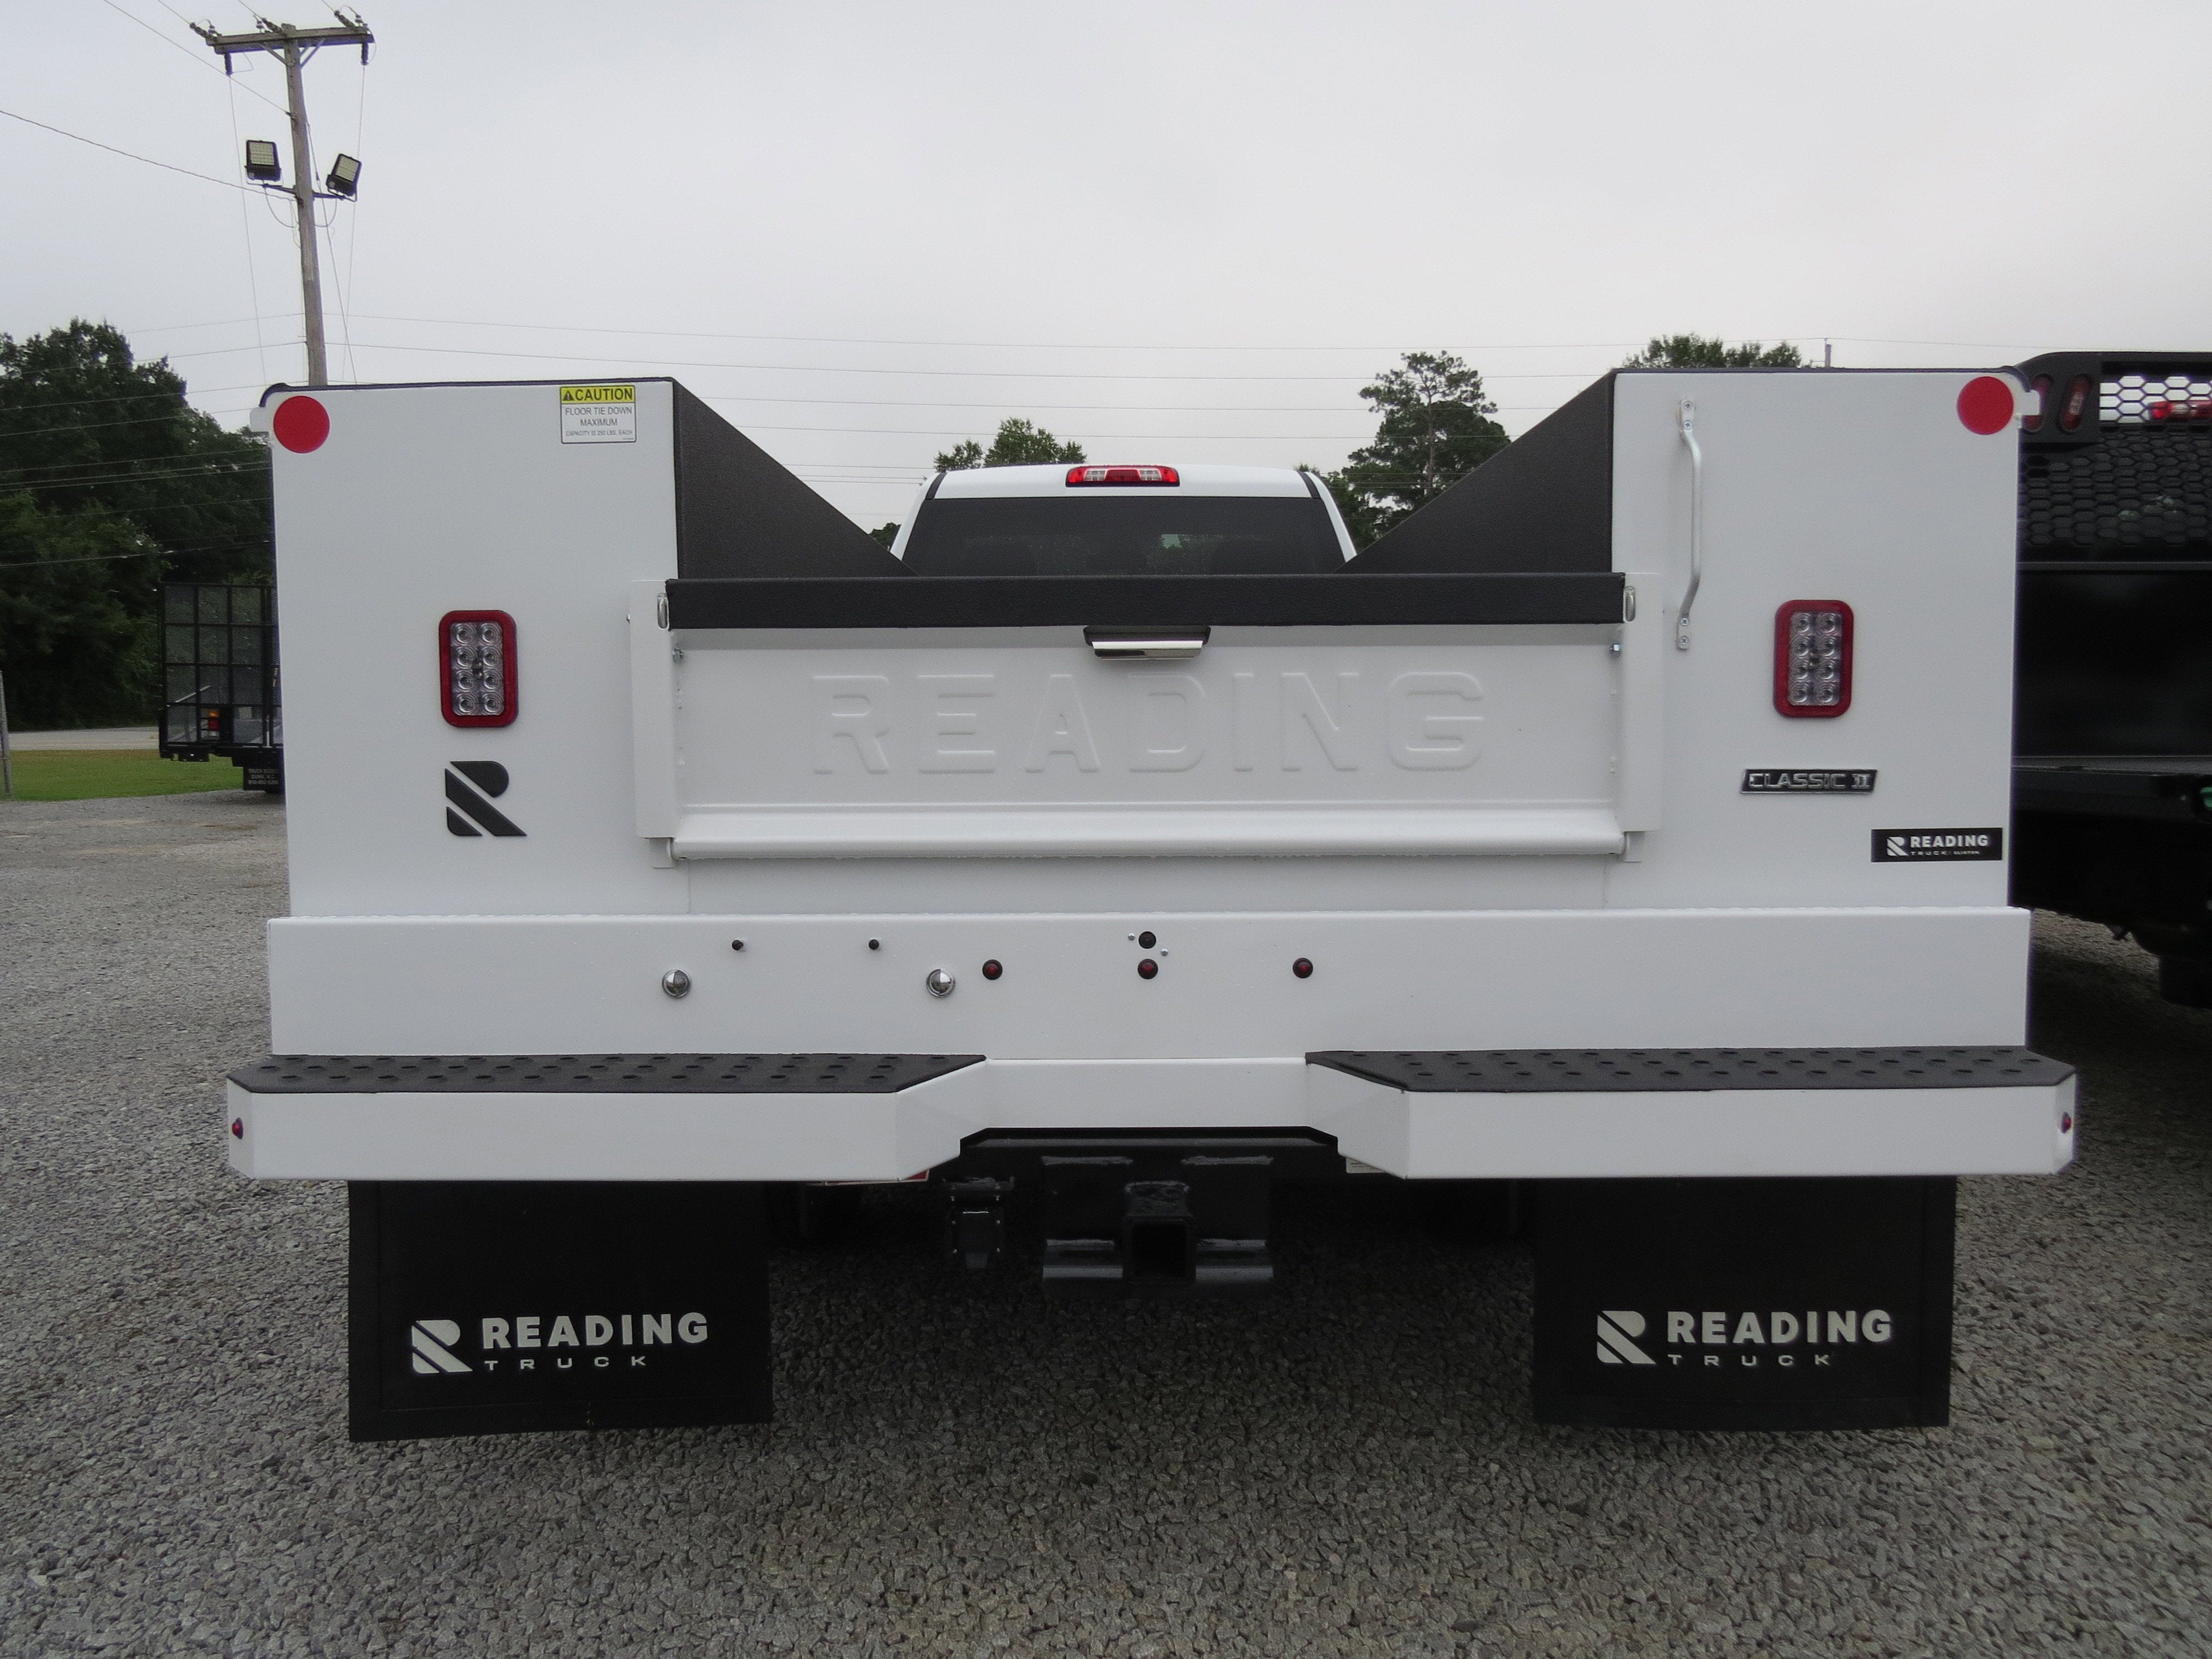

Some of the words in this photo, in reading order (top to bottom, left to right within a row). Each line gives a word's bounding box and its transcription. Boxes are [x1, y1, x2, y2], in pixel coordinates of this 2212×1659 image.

[575, 388, 633, 400] CAUTION
[565, 407, 592, 415] FLOOR
[608, 406, 633, 415] DOWN
[580, 418, 618, 426] MAXIMUM
[811, 671, 1485, 774] READING
[1748, 773, 1846, 789] CLASSIC
[1910, 834, 1989, 848] READING
[482, 1312, 708, 1349] READING
[1667, 1309, 1892, 1344] READING
[484, 1355, 646, 1371] TRUCK
[1667, 1354, 1832, 1367] TRUCK
